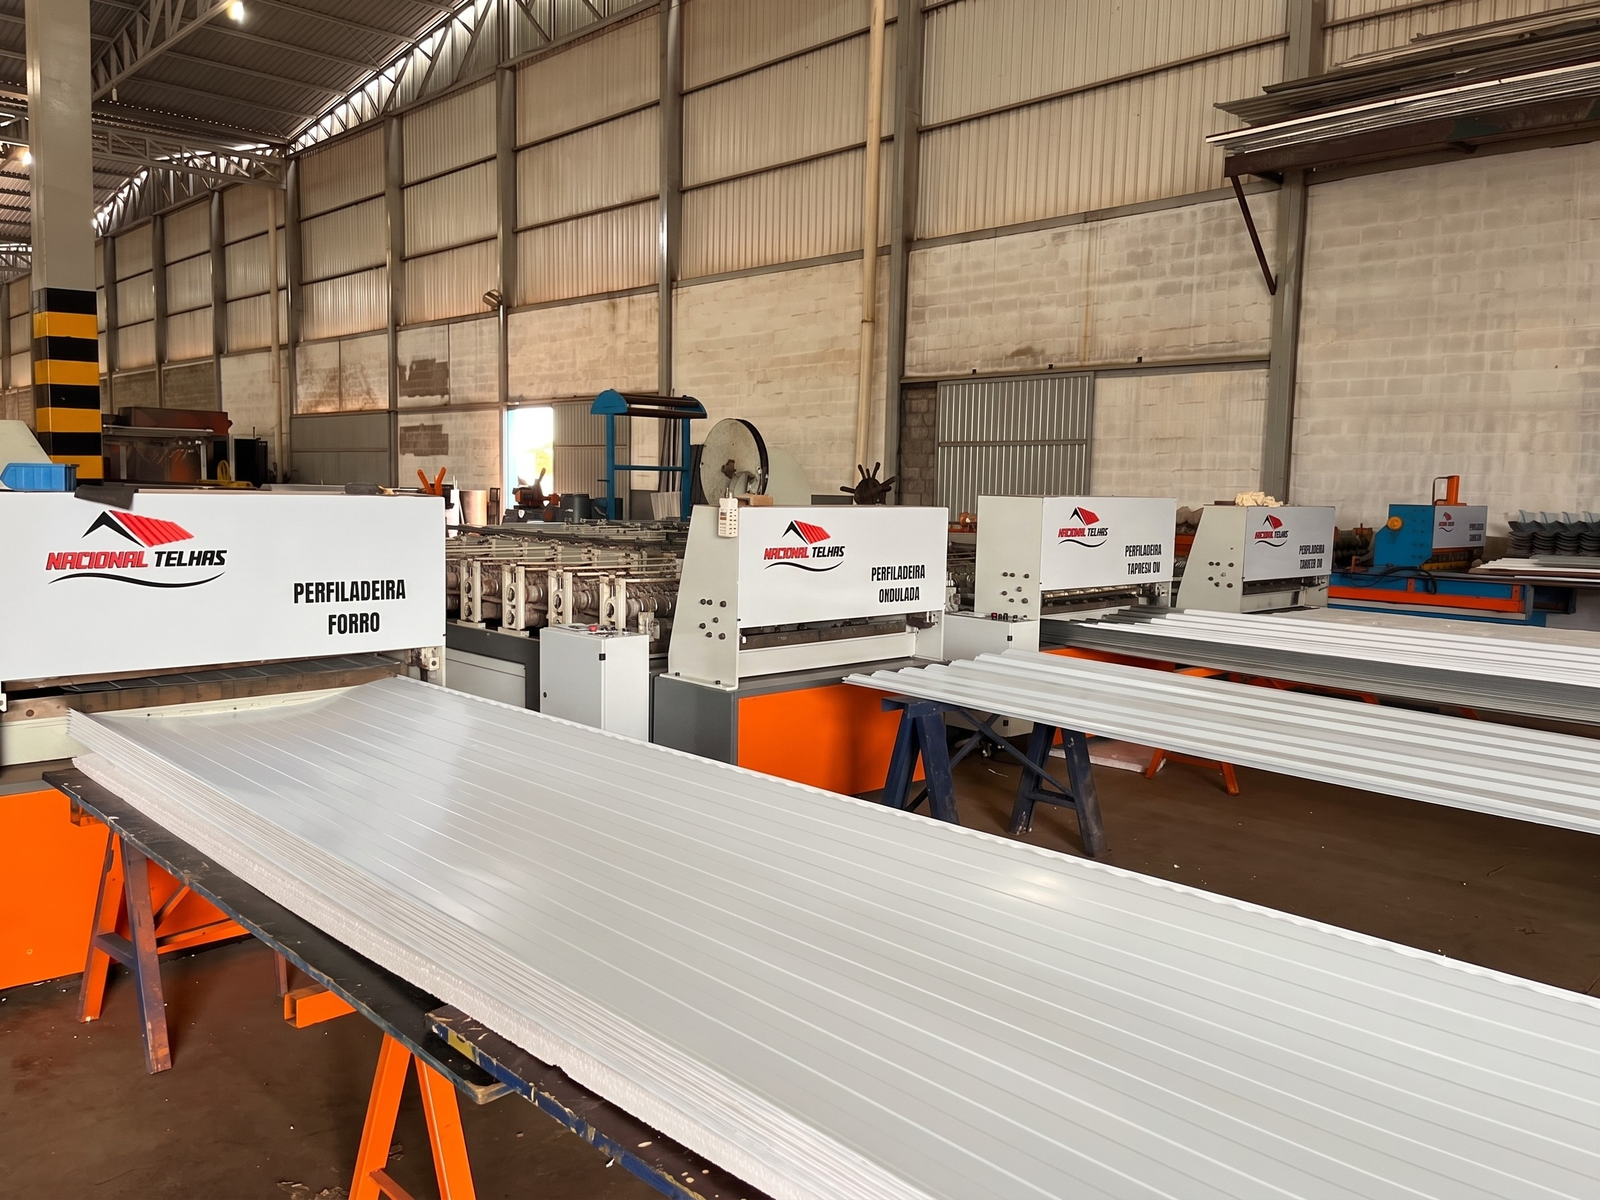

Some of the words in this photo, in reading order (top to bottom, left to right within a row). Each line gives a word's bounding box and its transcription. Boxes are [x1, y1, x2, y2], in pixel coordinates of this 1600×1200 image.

[764, 547, 809, 560] NACIONAL
[812, 546, 845, 558] TELHAS
[1125, 544, 1162, 557] PERFILADEIRA
[45, 552, 149, 571] NACIONAL
[154, 549, 228, 568] TELHAS
[871, 565, 926, 581] PERFILADEIRA
[293, 579, 406, 604] PERFILADEIRA
[879, 587, 920, 603] ONDULADA
[328, 612, 381, 635] FORRO
